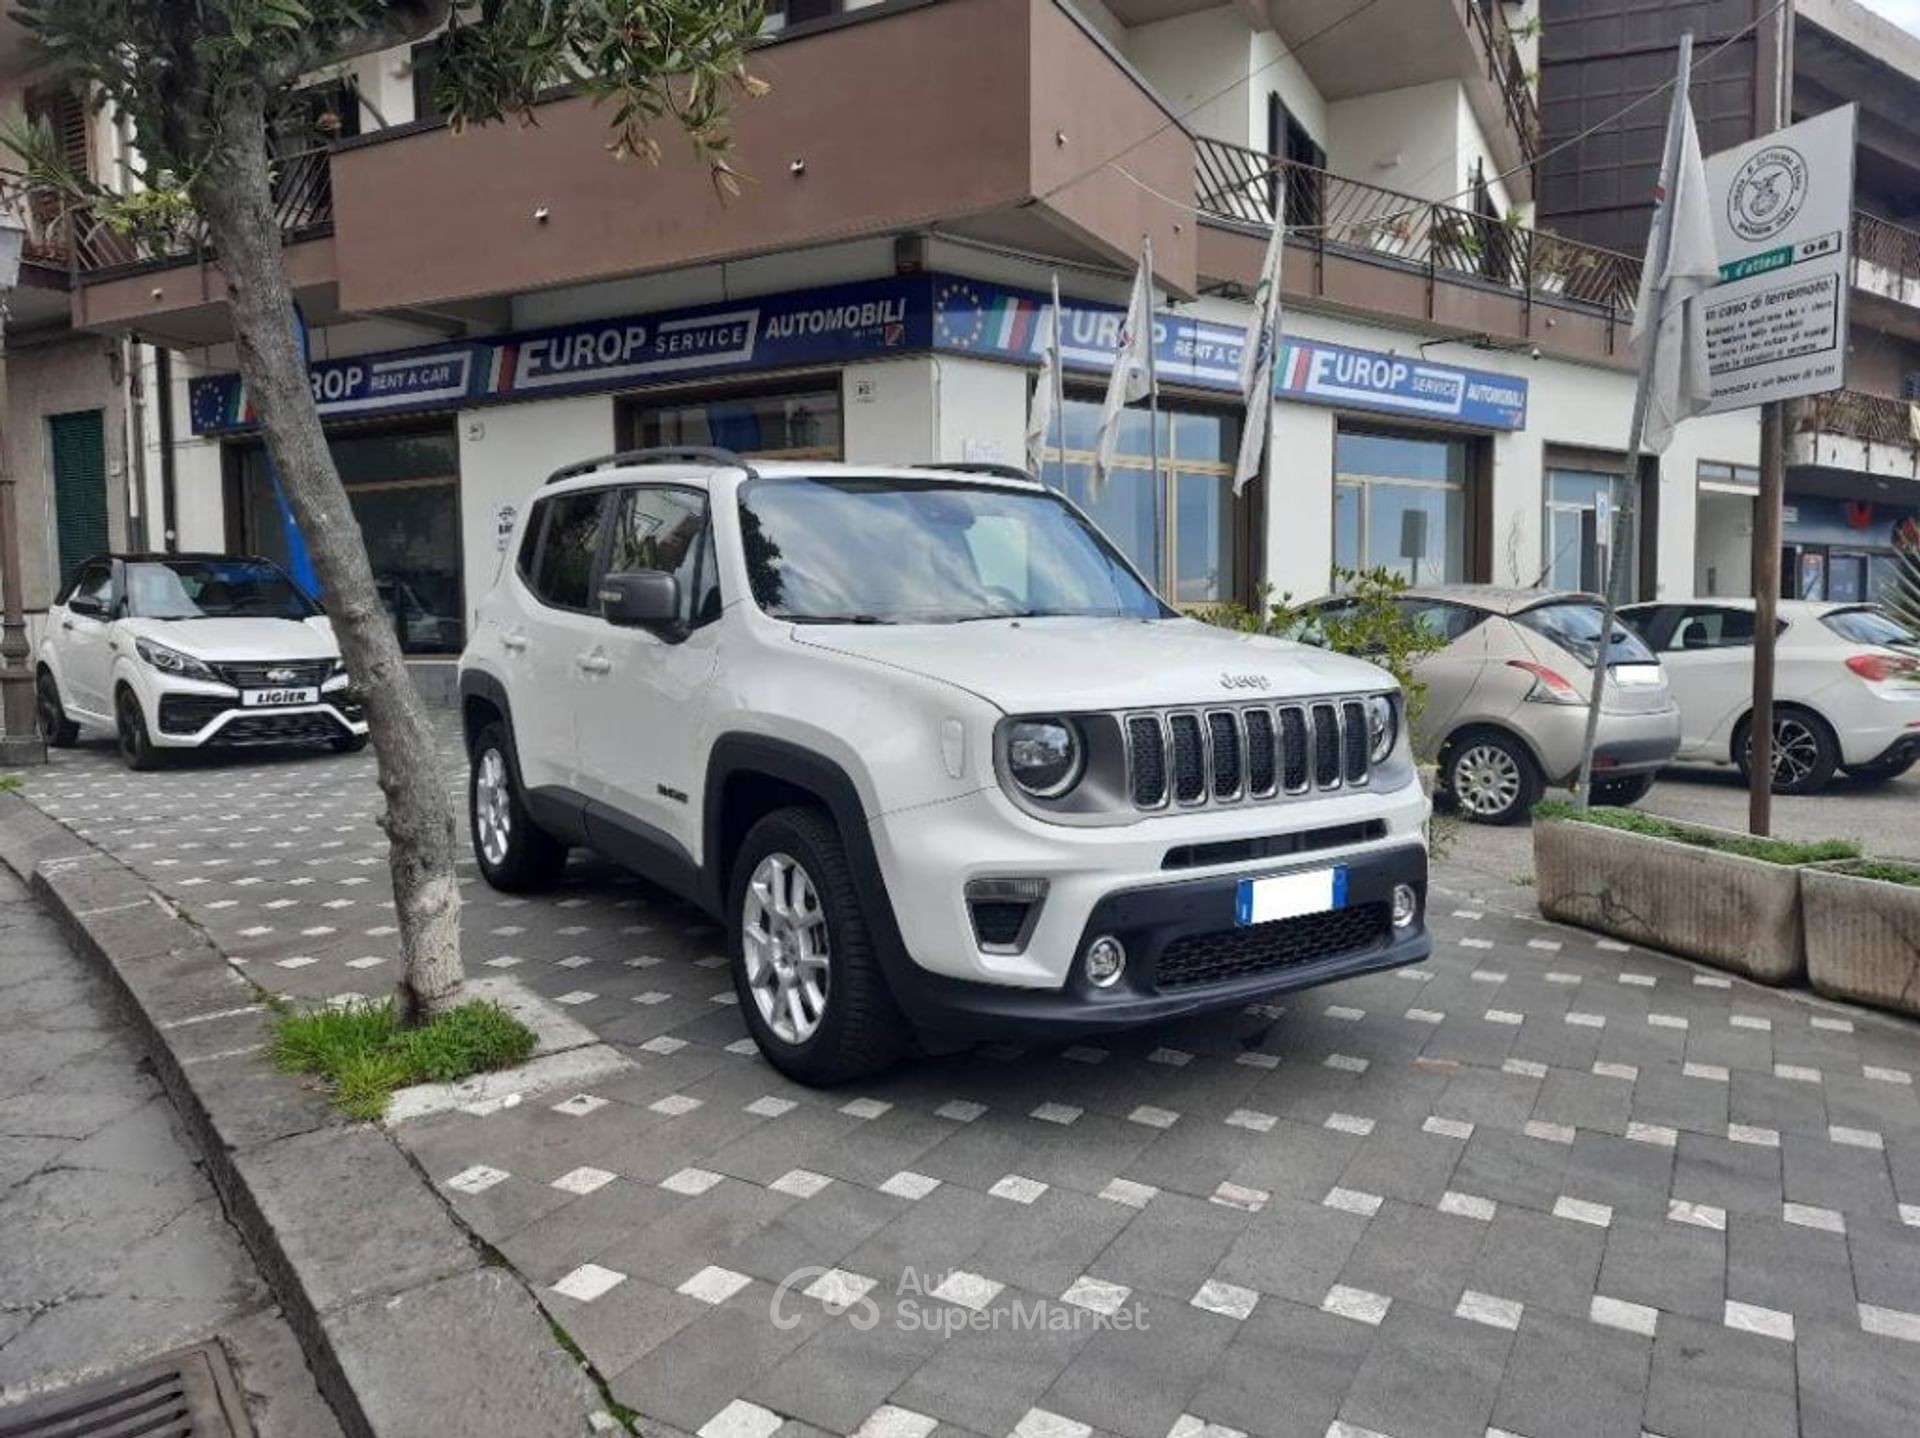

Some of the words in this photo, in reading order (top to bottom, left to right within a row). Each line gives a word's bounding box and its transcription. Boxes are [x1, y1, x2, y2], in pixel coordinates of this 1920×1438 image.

[514, 326, 646, 389] EUROP
[655, 326, 744, 354] SERVICE
[765, 298, 906, 339] AUTOMOBILI
[371, 373, 406, 391] RENT
[408, 372, 417, 386] A
[420, 366, 450, 384] CAR
[1305, 349, 1408, 393] EUROP
[1411, 376, 1458, 397] SERVICE
[1220, 673, 1271, 691] Jeep
